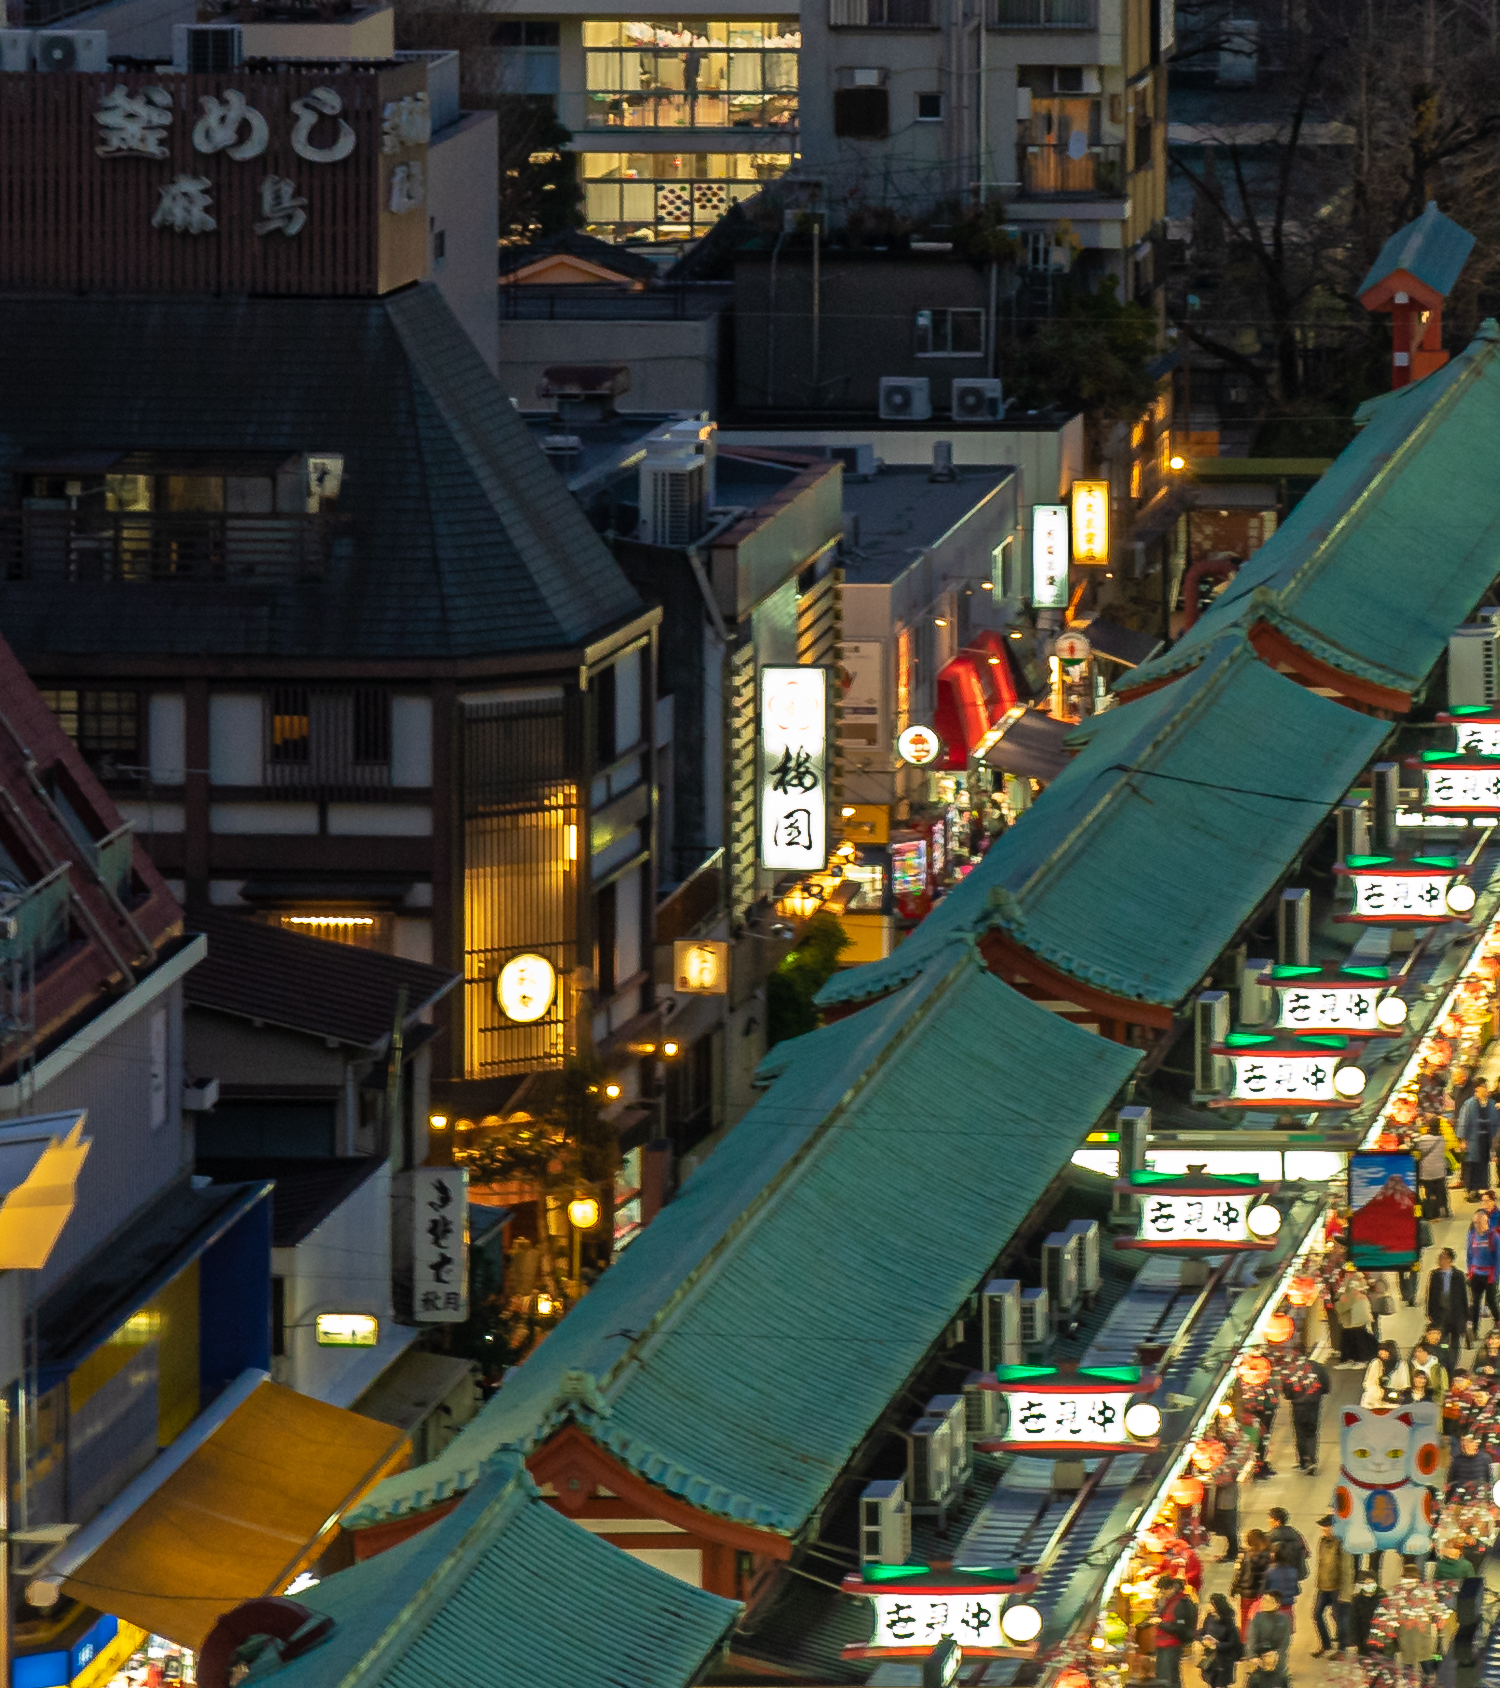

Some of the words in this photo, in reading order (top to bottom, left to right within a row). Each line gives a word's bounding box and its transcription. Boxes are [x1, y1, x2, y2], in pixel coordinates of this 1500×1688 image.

[94, 84, 357, 163] 釜めし
[151, 175, 308, 237] 麻鳥
[769, 745, 819, 851] 梅園
